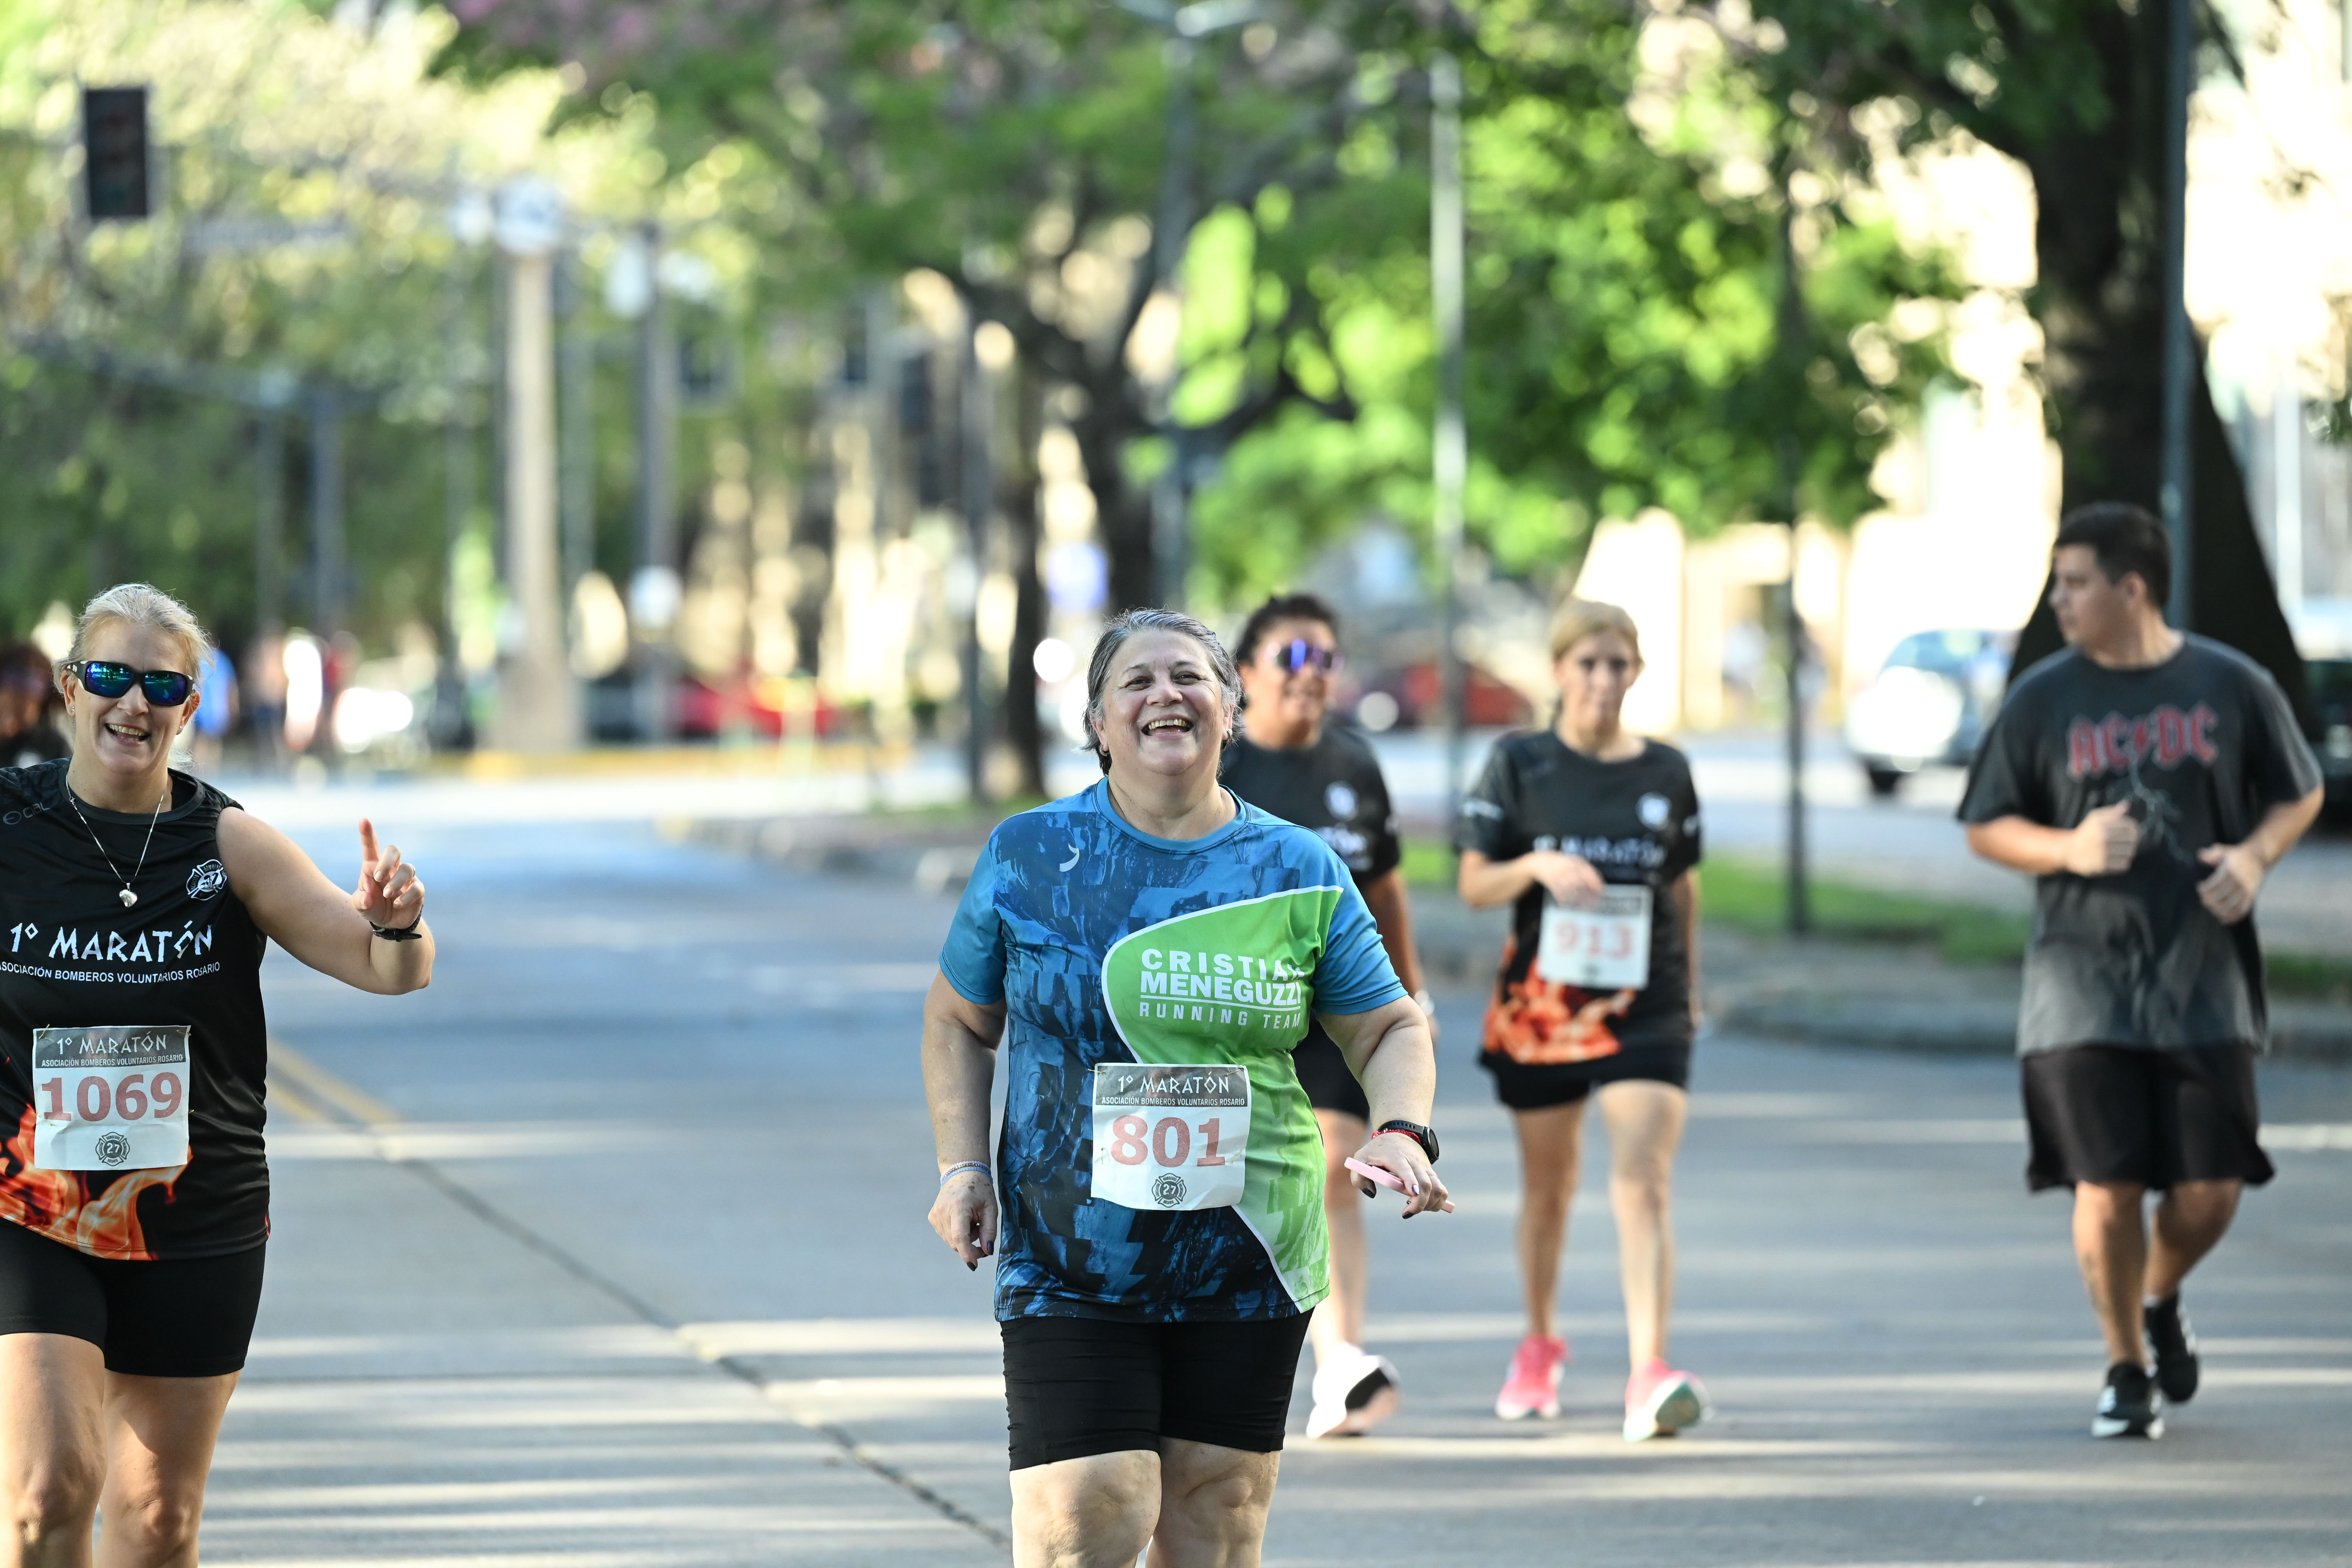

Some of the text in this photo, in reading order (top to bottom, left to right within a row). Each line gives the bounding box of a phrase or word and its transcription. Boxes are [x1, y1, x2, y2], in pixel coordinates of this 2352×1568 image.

[49, 920, 212, 962] MARATÓN
[1556, 919, 1633, 960] 913
[0, 961, 220, 984] SOCIACIÓN BOMBEROS VOLUNTARIOS ROSARIO
[1141, 971, 1301, 1006] MENEGUZZI
[1139, 1002, 1300, 1029] RUNNING TEAM
[79, 1031, 166, 1054] MARATÓN
[42, 1057, 79, 1067] ASOCIACIÓN
[117, 1056, 156, 1065] VOLUNTARIOS
[158, 1054, 183, 1062] ROSARIO
[1139, 1071, 1229, 1094] MARATÓN
[41, 1072, 182, 1122] 1069
[1101, 1096, 1139, 1105] ASOCIACIÓN
[107, 1142, 120, 1154] 27
[1110, 1115, 1225, 1168] 801
[1163, 1183, 1176, 1195] 27
